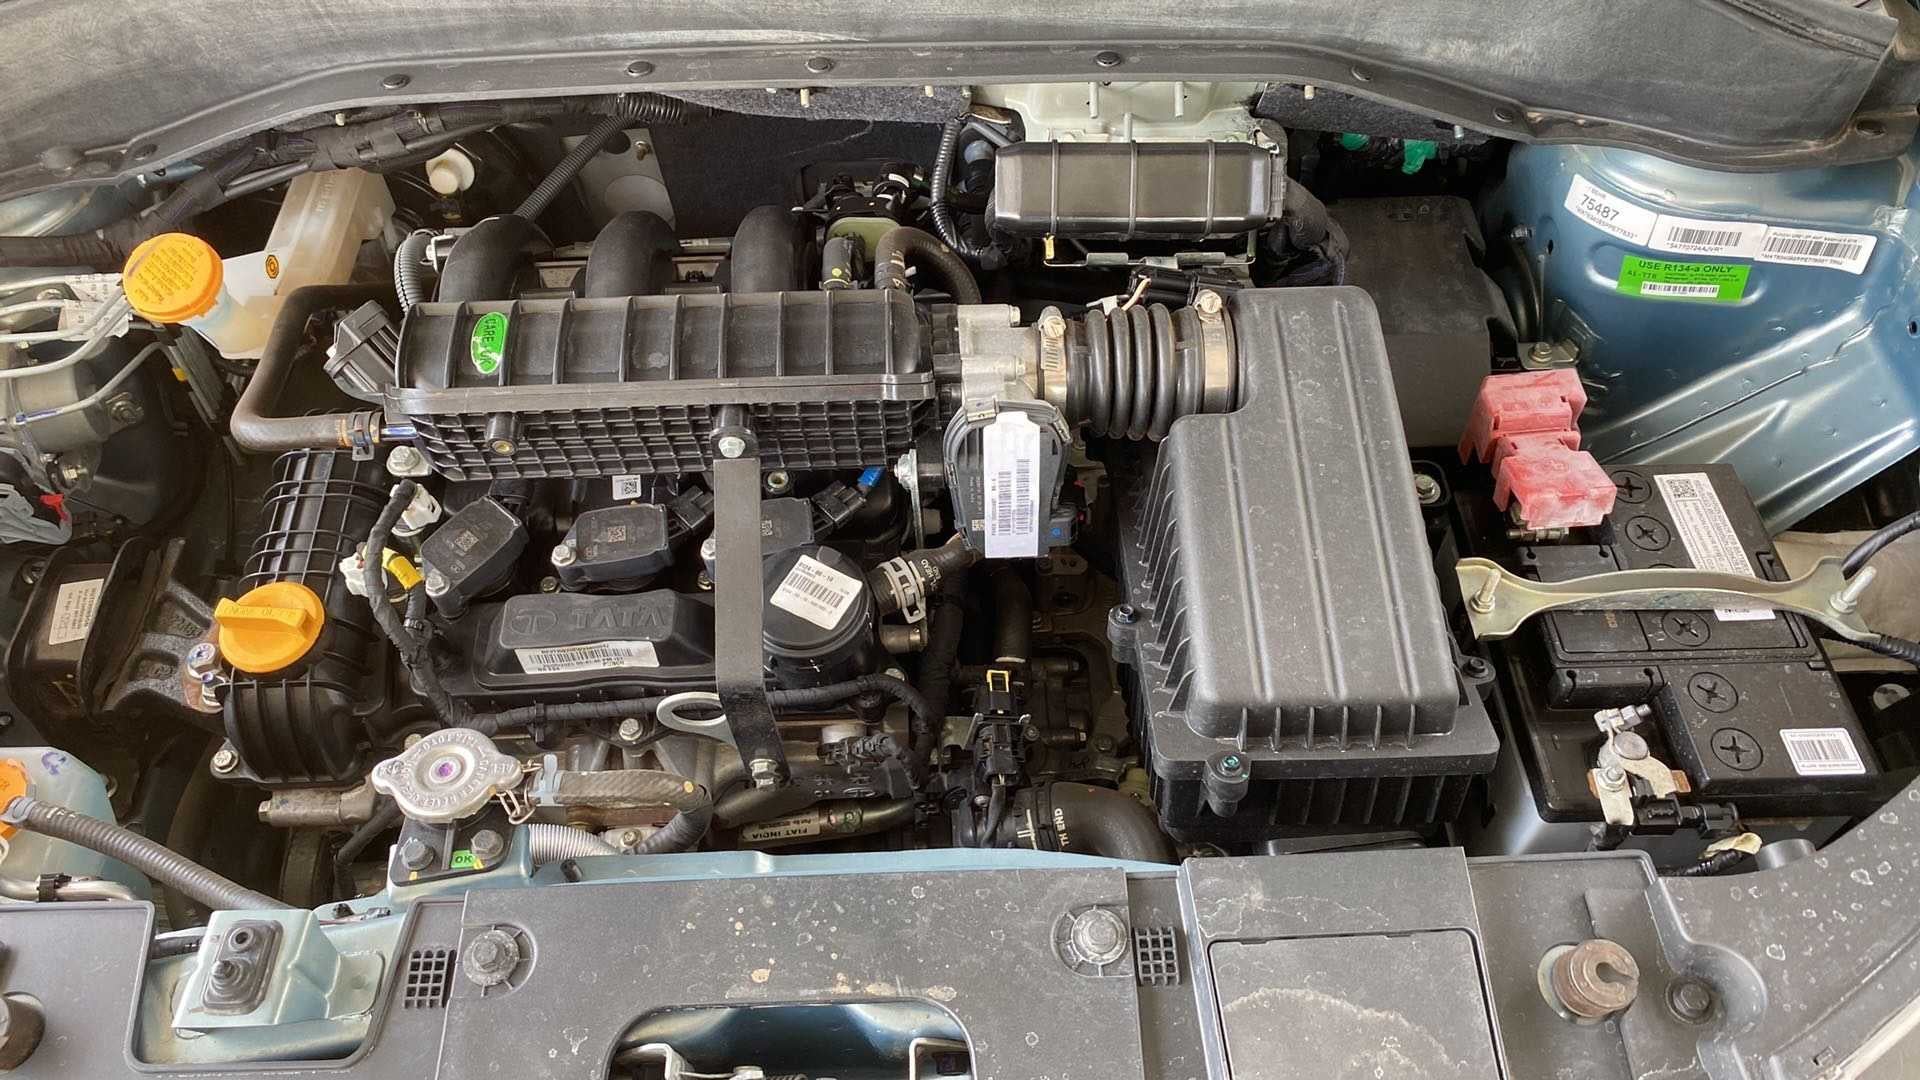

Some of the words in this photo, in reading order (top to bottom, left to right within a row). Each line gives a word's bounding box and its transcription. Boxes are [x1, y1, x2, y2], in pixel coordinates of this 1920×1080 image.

[1580, 194, 1620, 221] 75487
[1638, 260, 1660, 270] USE
[1703, 265, 1734, 273] ONLY
[571, 605, 665, 630] TATA
[1054, 808, 1066, 832] END
[752, 830, 781, 840] INDIA
[784, 827, 808, 836] FIAT
[455, 855, 472, 864] OK
